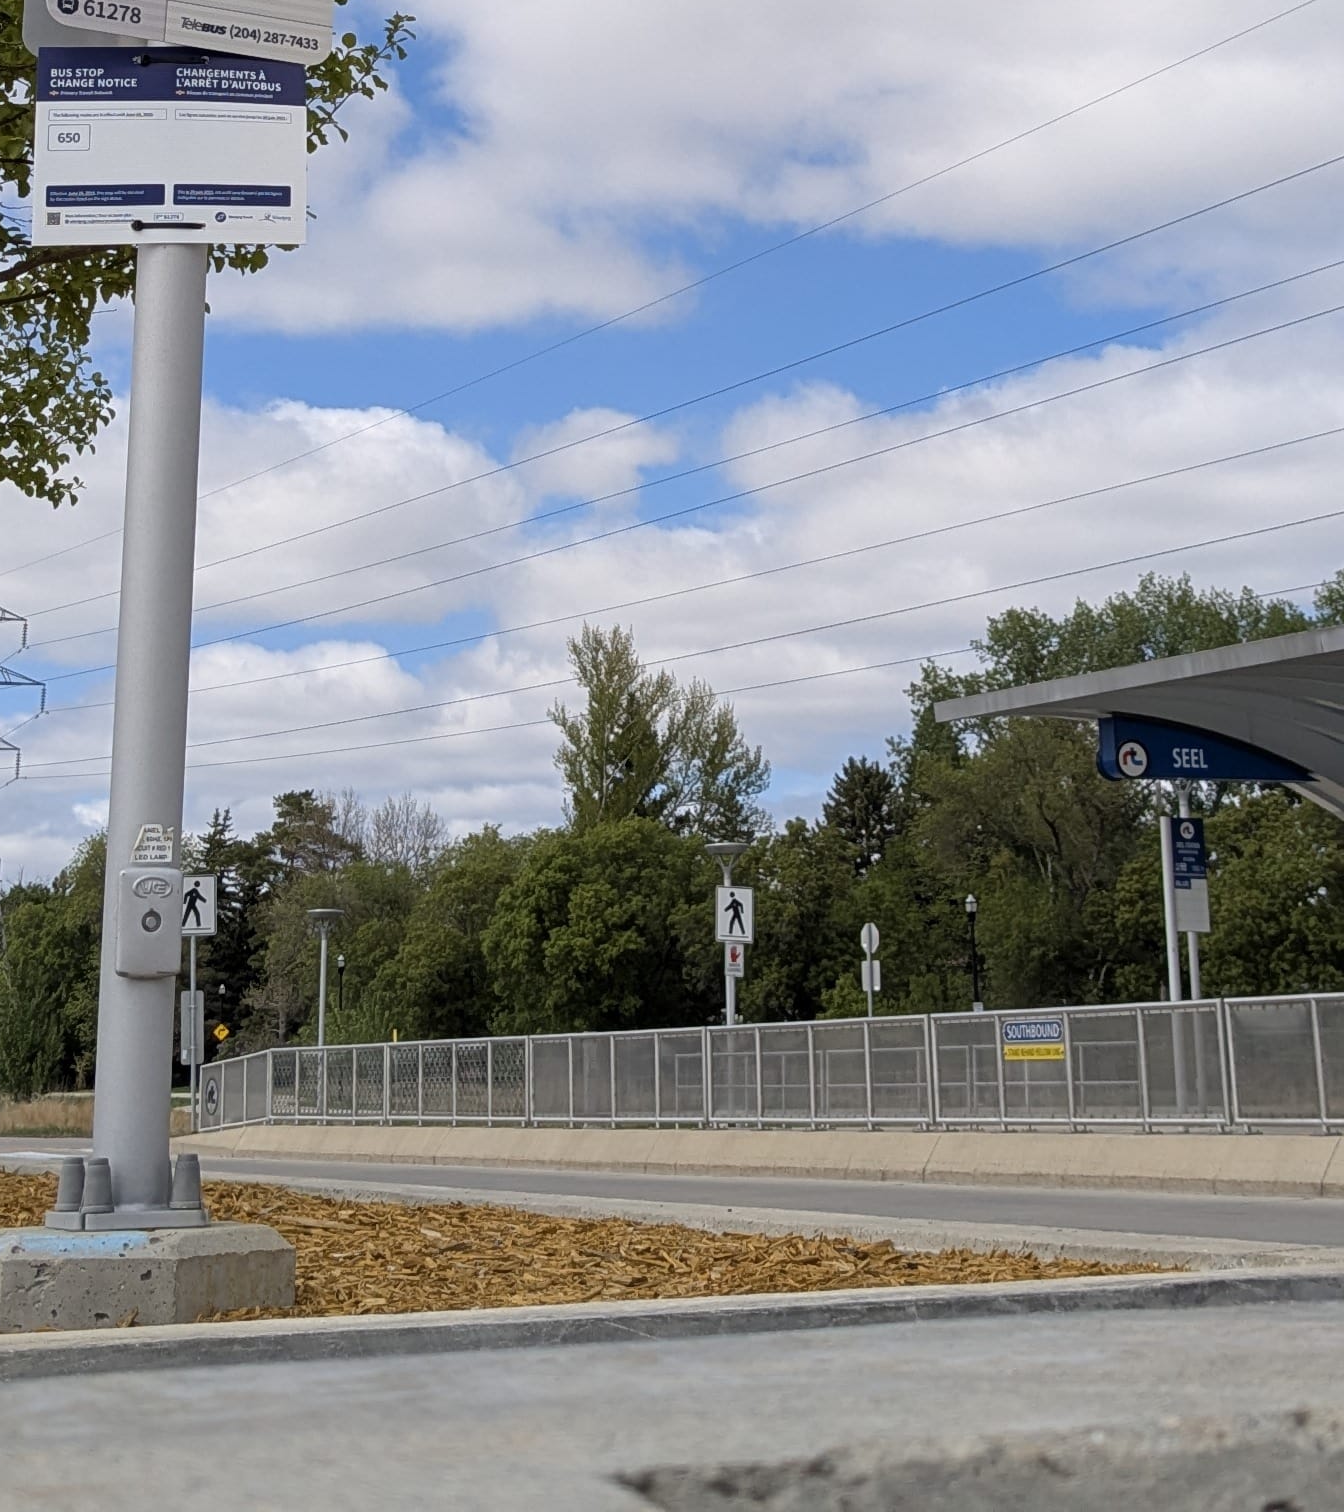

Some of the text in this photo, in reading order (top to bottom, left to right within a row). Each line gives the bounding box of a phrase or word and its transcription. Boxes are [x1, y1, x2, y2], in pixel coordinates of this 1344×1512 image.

[83, 0, 142, 24] 61278
[229, 24, 261, 44] (204)
[263, 31, 319, 51] 287-7433
[50, 68, 105, 77] BUS STOP
[176, 68, 266, 81] CHANGEMENTS À
[50, 78, 138, 88] CHANGE NOTICE
[176, 77, 282, 92] L'ARRÊT D'AUTOBUS
[57, 132, 81, 143] 650
[1172, 747, 1209, 769] SEEL
[1006, 1023, 1060, 1039] SOUTHBOUND
